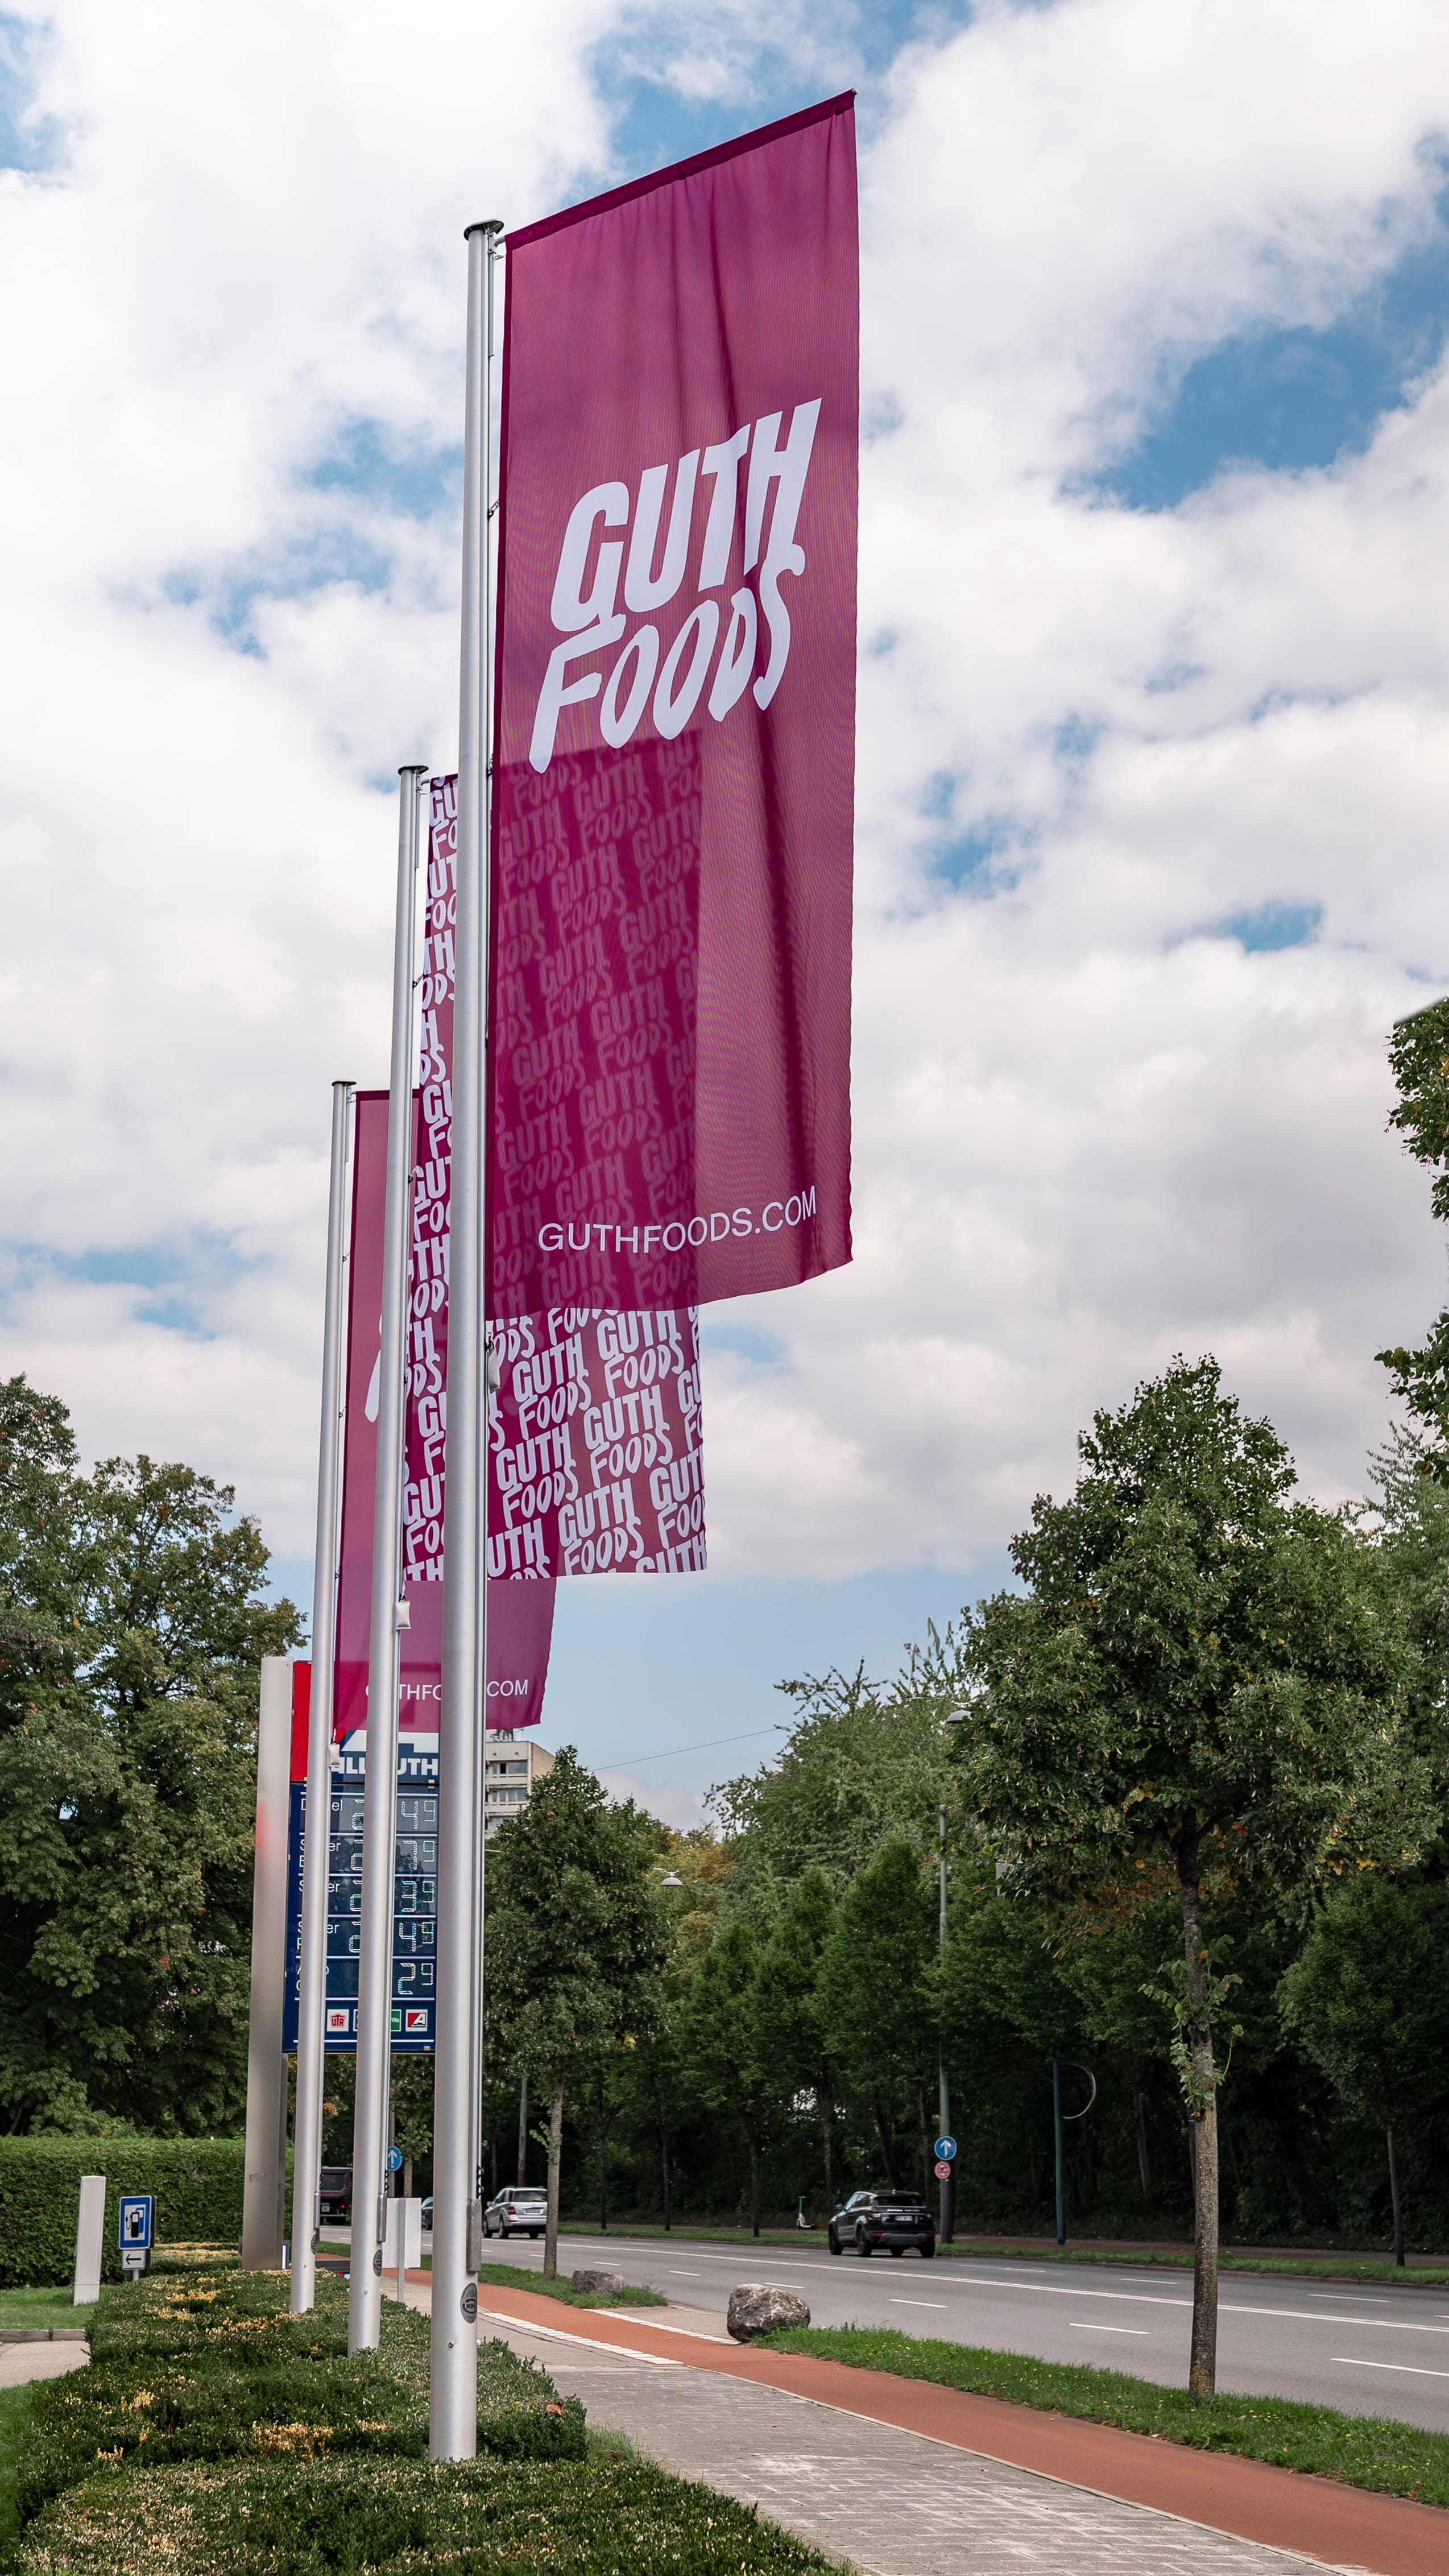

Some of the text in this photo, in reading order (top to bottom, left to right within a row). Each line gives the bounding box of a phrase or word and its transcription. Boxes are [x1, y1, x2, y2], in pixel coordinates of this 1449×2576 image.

[550, 397, 822, 631] GUTH
[528, 543, 806, 774] FOODS
[430, 780, 458, 826] GU
[423, 929, 455, 975] TH
[415, 1157, 452, 1204] GU
[494, 1196, 543, 1254] UTH
[538, 1185, 817, 1254] GUTHFOODS.COM
[412, 1233, 449, 1281] TH
[597, 1299, 682, 1361] GUTH
[512, 1332, 589, 1403] GUTH
[605, 1333, 684, 1399] FOODS
[519, 1368, 591, 1440] FOODS
[583, 1384, 670, 1450] GUTH
[495, 1422, 574, 1491] GUTH
[590, 1422, 673, 1488] FOODS
[403, 1472, 445, 1525] GU
[502, 1458, 579, 1529] FOODS
[558, 1478, 638, 1547] GUTH
[658, 1488, 705, 1549] FOO
[487, 1518, 549, 1577] UTH
[564, 1516, 644, 1576] FOODS
[331, 2015, 345, 2026] UTA
